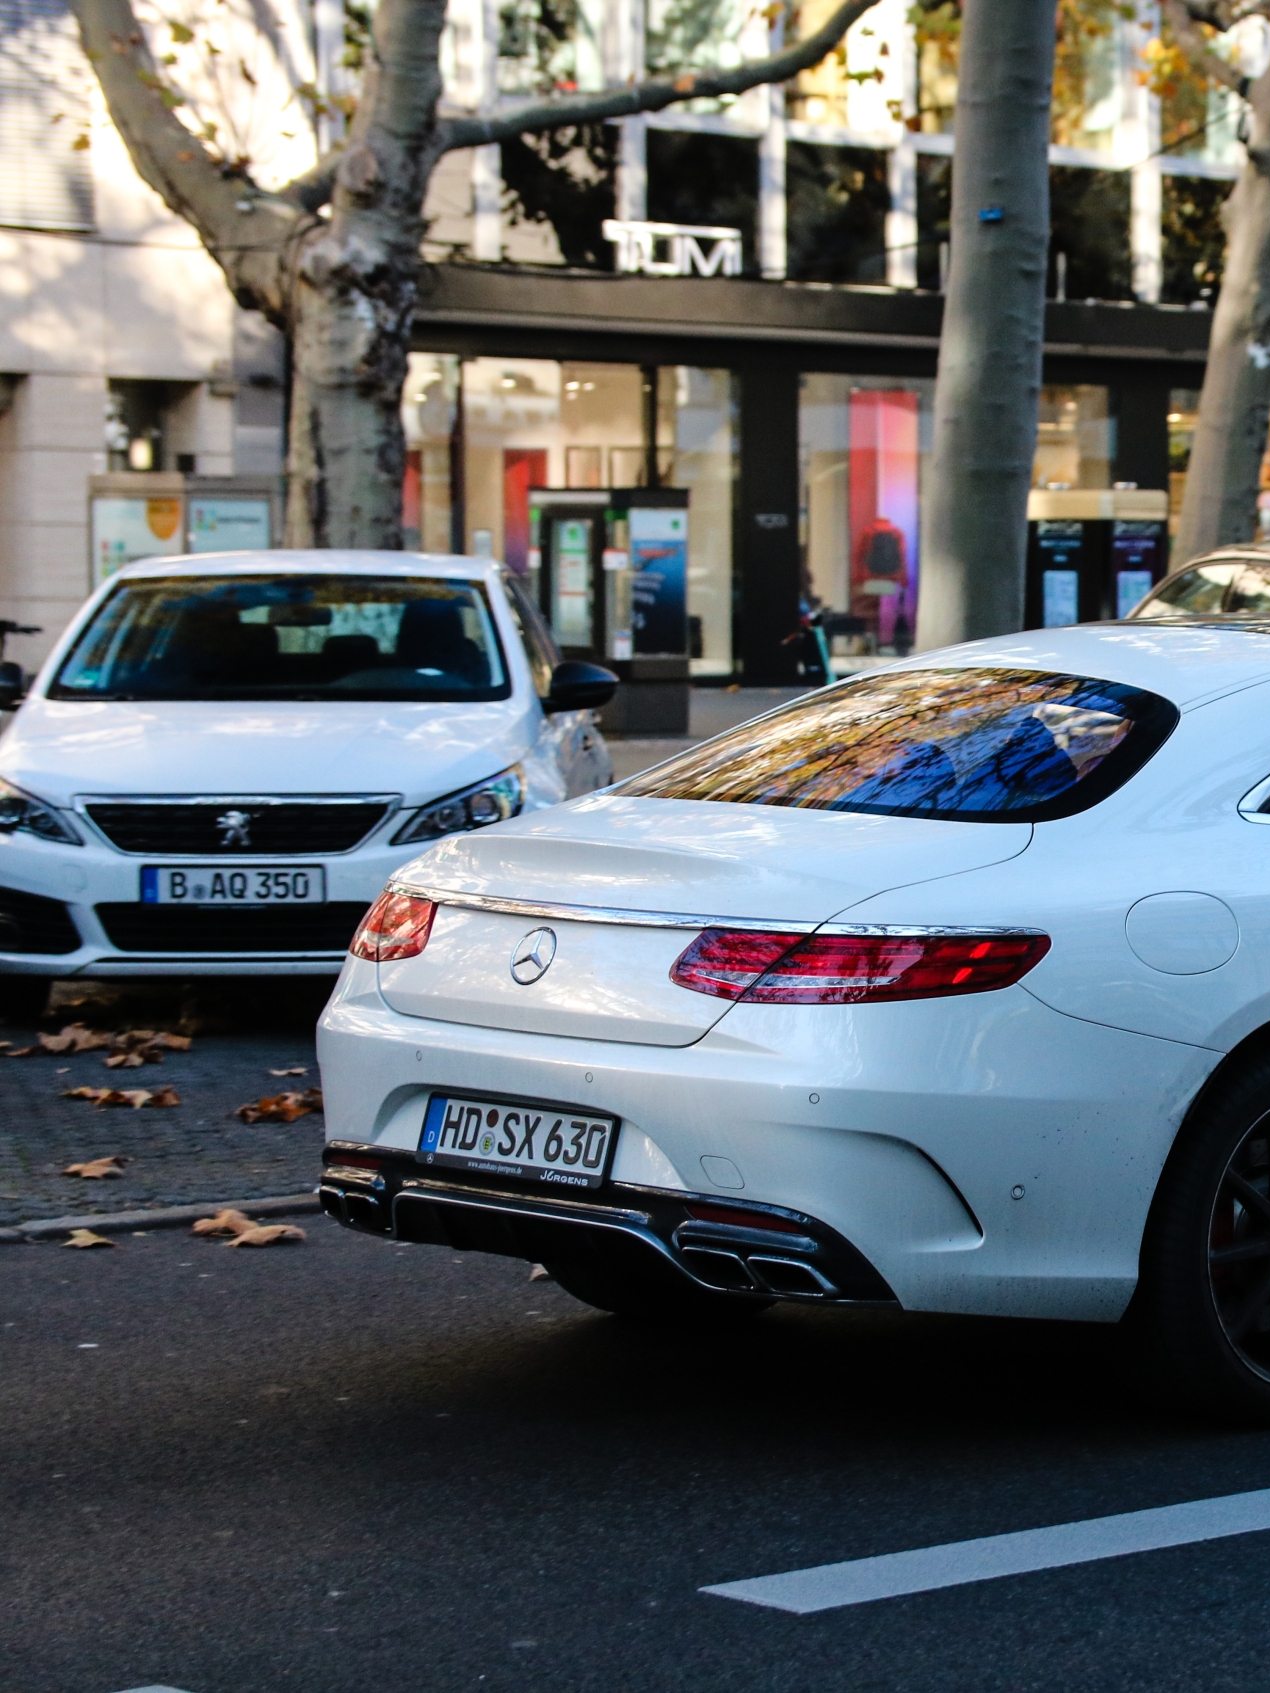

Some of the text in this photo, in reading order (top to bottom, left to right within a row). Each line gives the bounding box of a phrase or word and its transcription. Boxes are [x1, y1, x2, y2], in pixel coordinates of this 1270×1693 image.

[602, 219, 742, 277] TUMI
[170, 872, 309, 899] B AQ 350
[427, 1130, 436, 1144] D
[440, 1104, 609, 1168] HD SX 630
